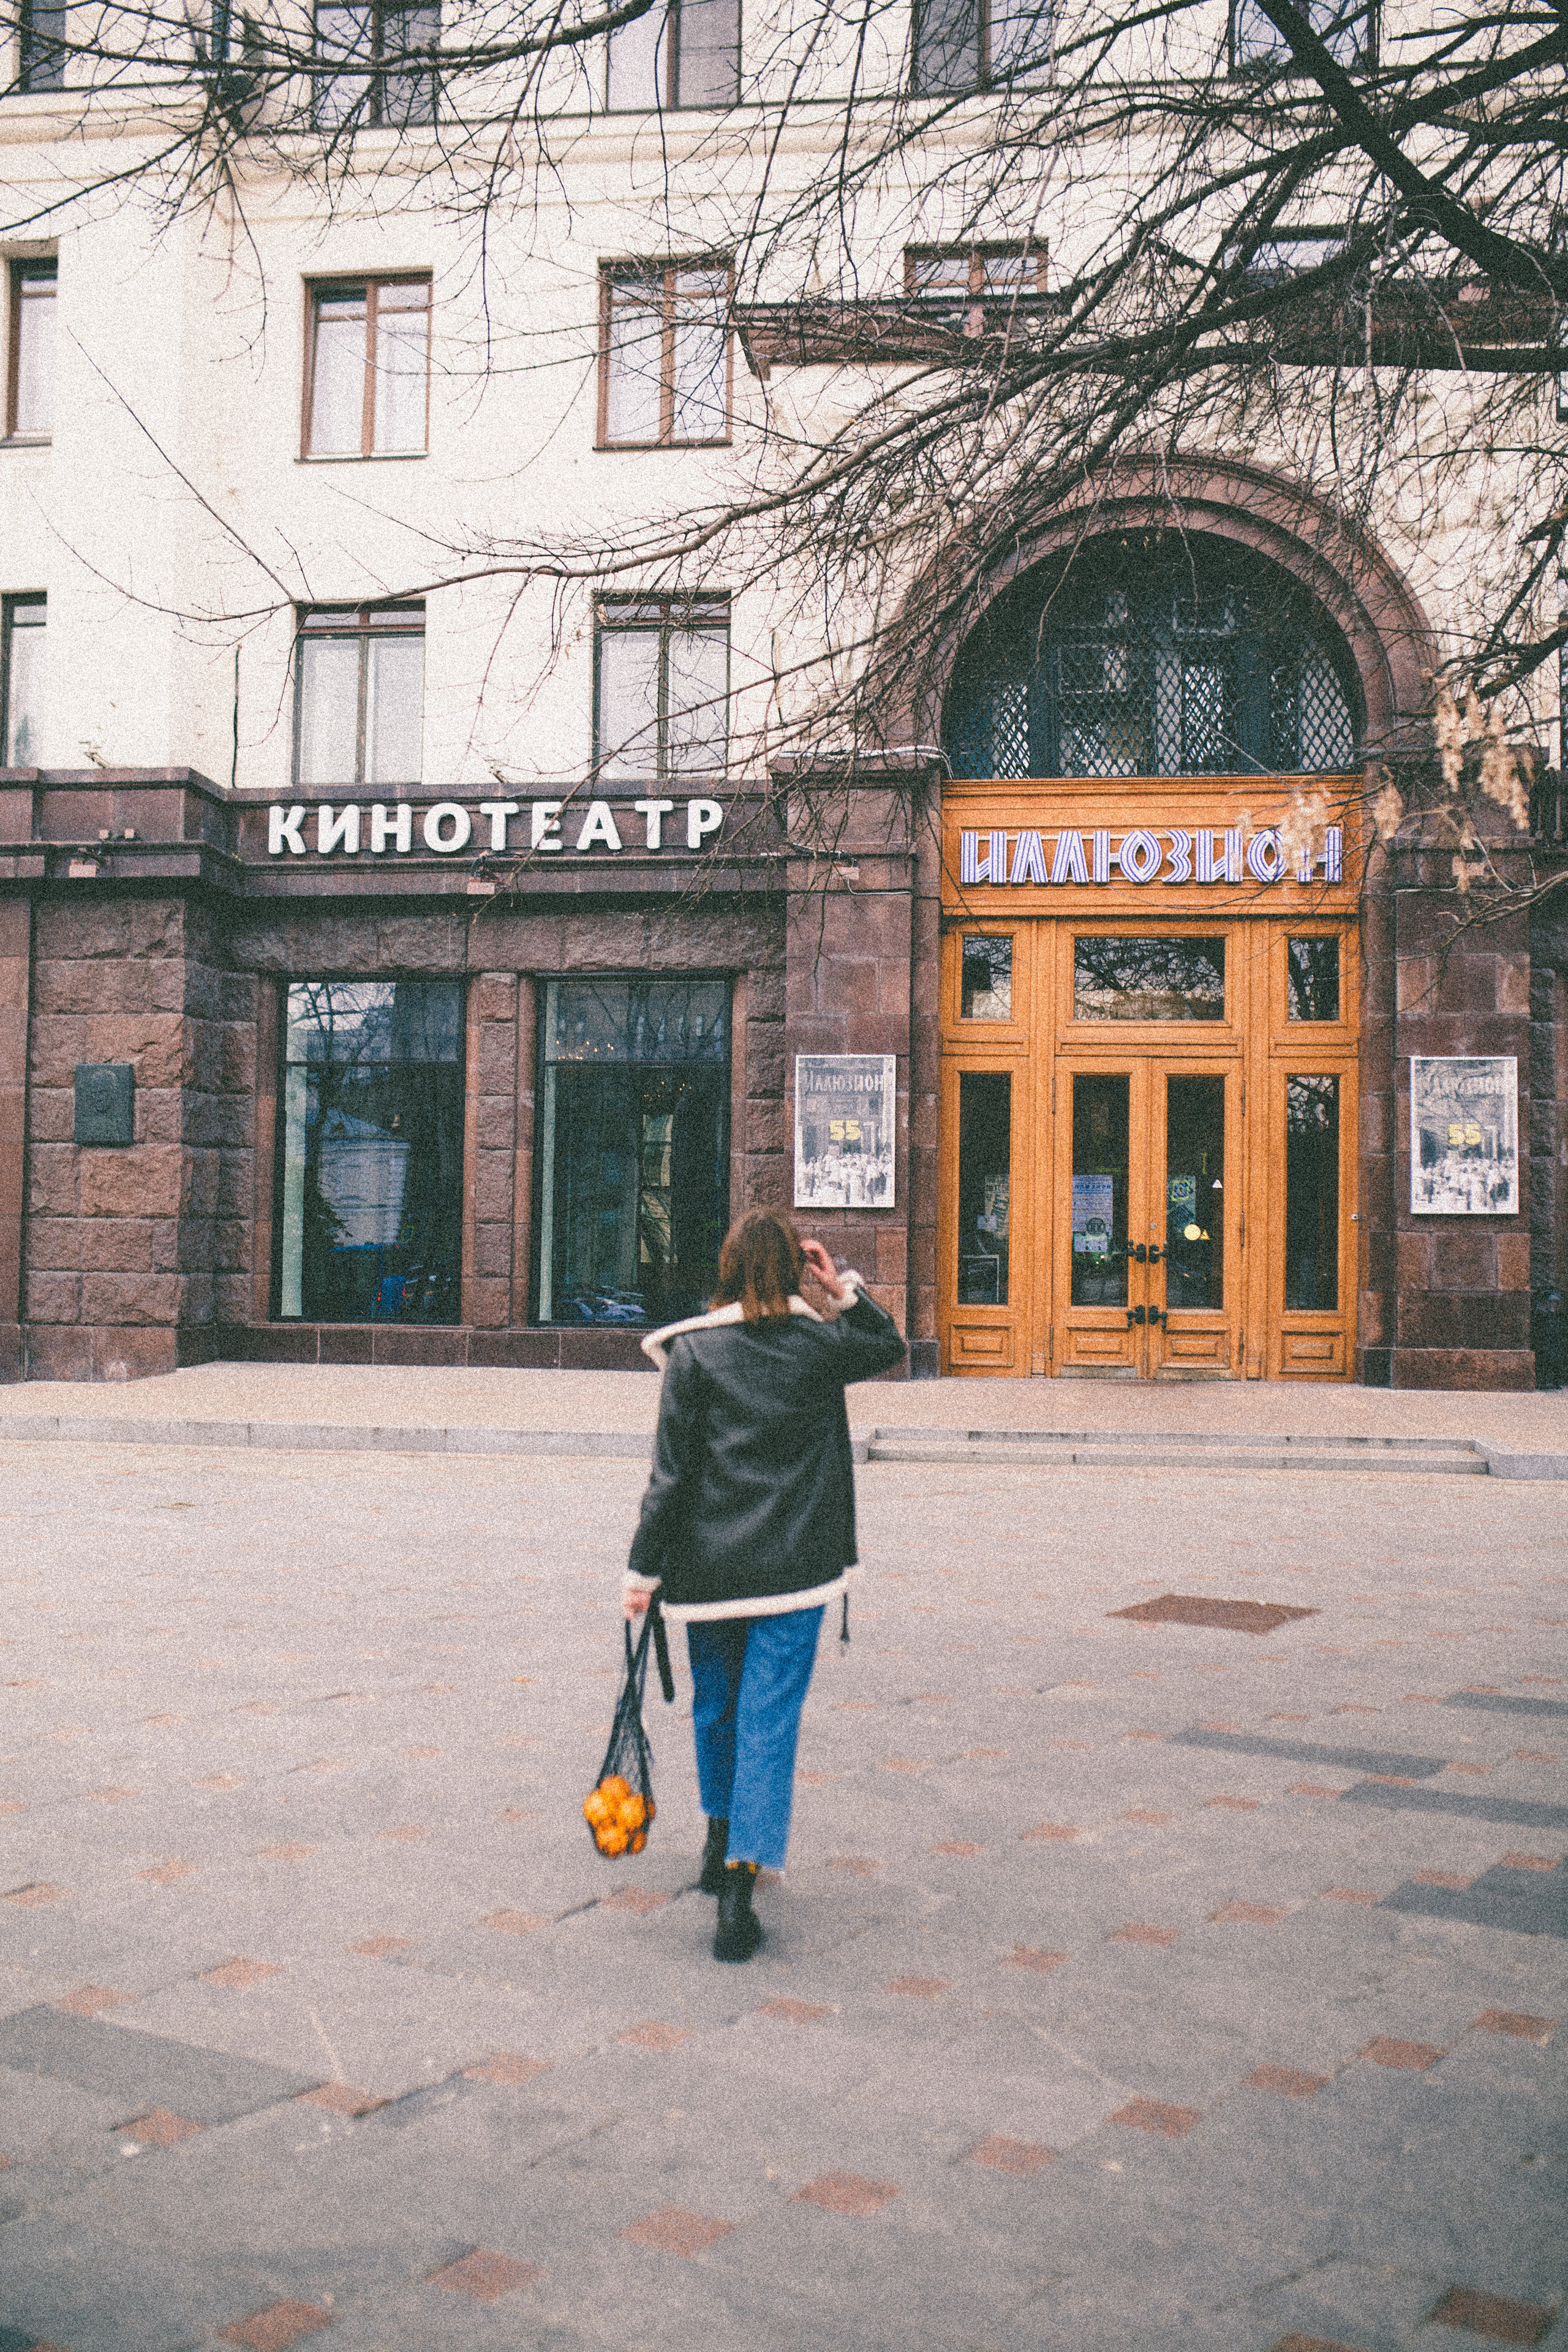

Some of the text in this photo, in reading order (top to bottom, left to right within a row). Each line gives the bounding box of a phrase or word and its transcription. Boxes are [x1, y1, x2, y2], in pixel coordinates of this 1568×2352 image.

[268, 799, 724, 854] КИНОТЕАТР
[960, 826, 1342, 883] ИЛЛЮЗИОН
[829, 1120, 861, 1141] 55
[1448, 1123, 1482, 1145] 55
